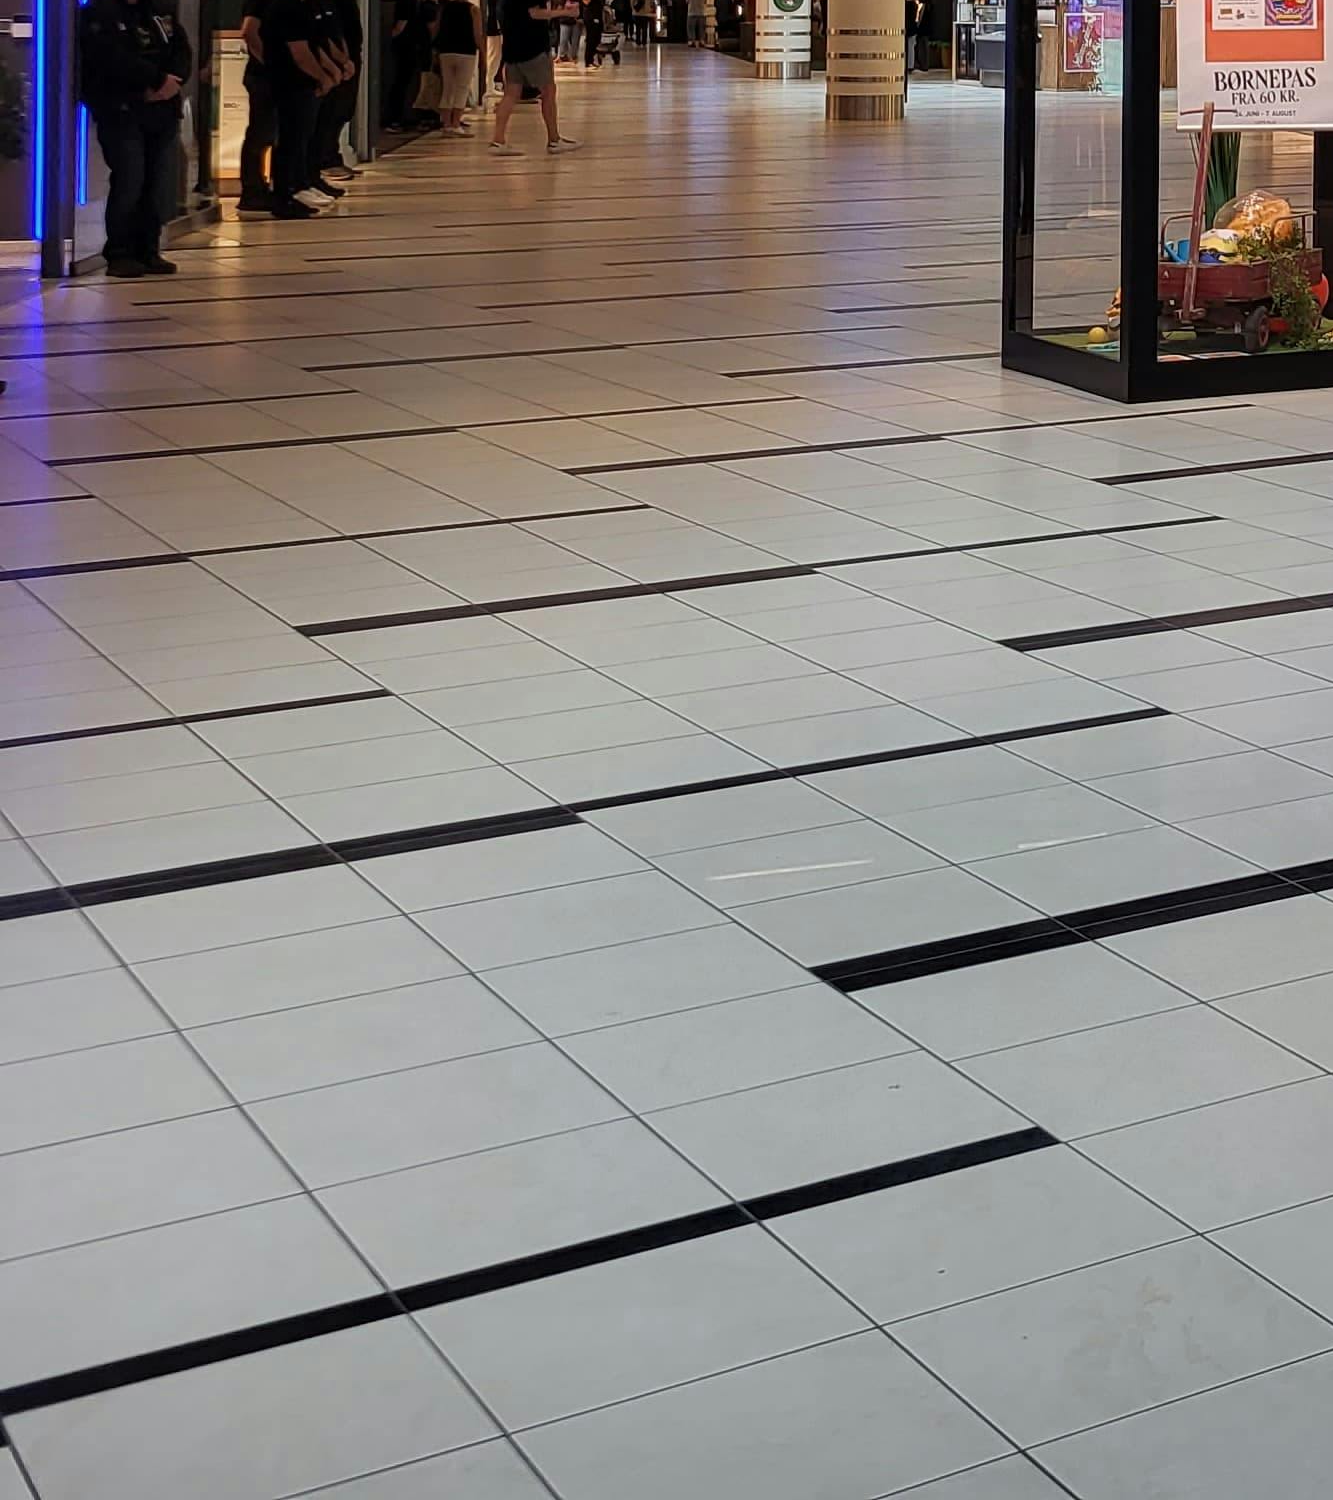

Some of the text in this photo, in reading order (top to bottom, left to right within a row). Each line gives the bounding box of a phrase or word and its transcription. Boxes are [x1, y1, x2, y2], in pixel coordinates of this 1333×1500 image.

[1214, 66, 1317, 92] BØRNEPAS
[1231, 89, 1300, 106] FRA 60 KR.
